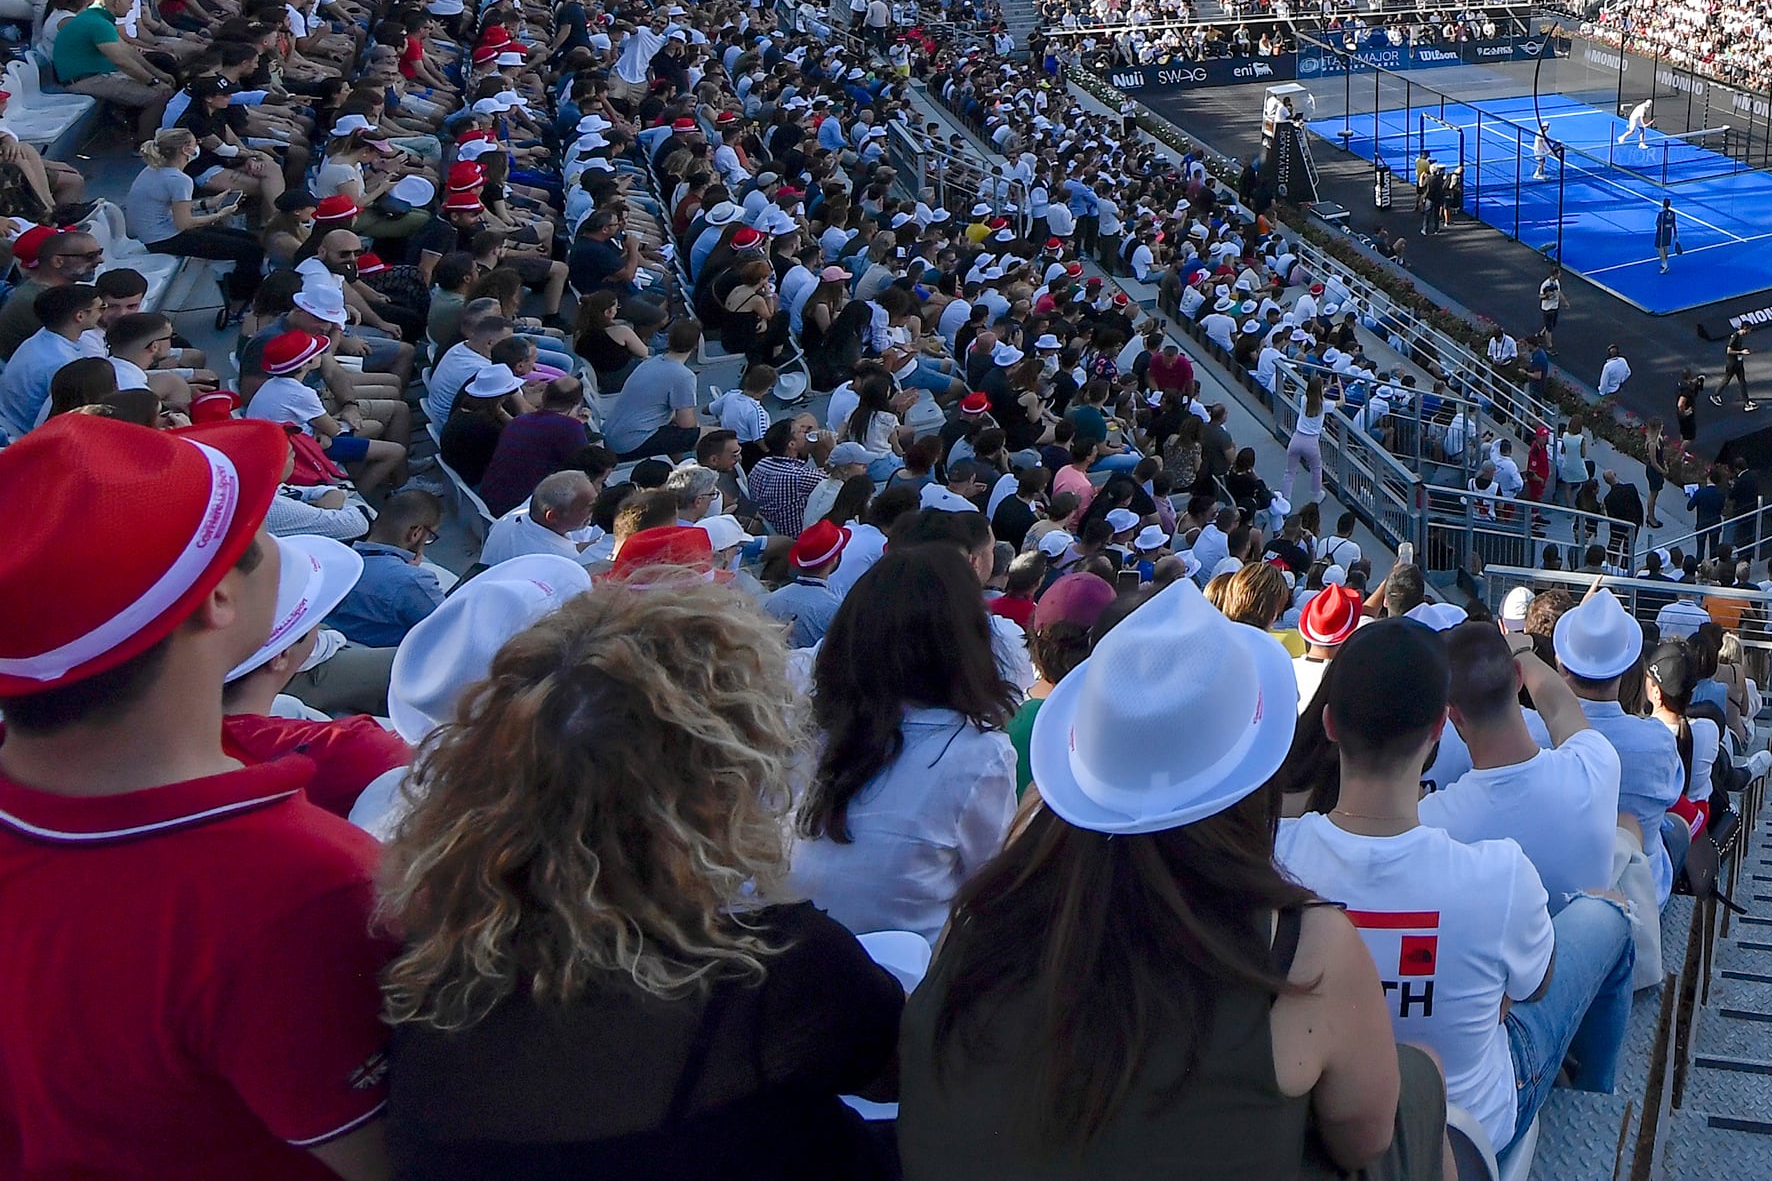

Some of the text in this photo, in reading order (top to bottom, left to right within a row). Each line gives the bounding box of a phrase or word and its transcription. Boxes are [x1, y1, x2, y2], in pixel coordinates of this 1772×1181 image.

[1419, 50, 1458, 62] Wilson
[1590, 53, 1629, 72] MONDO
[1158, 68, 1207, 85] SWAG
[1233, 64, 1253, 78] eni
[1661, 71, 1704, 96] MONDO
[1382, 170, 1391, 207] Wilson
